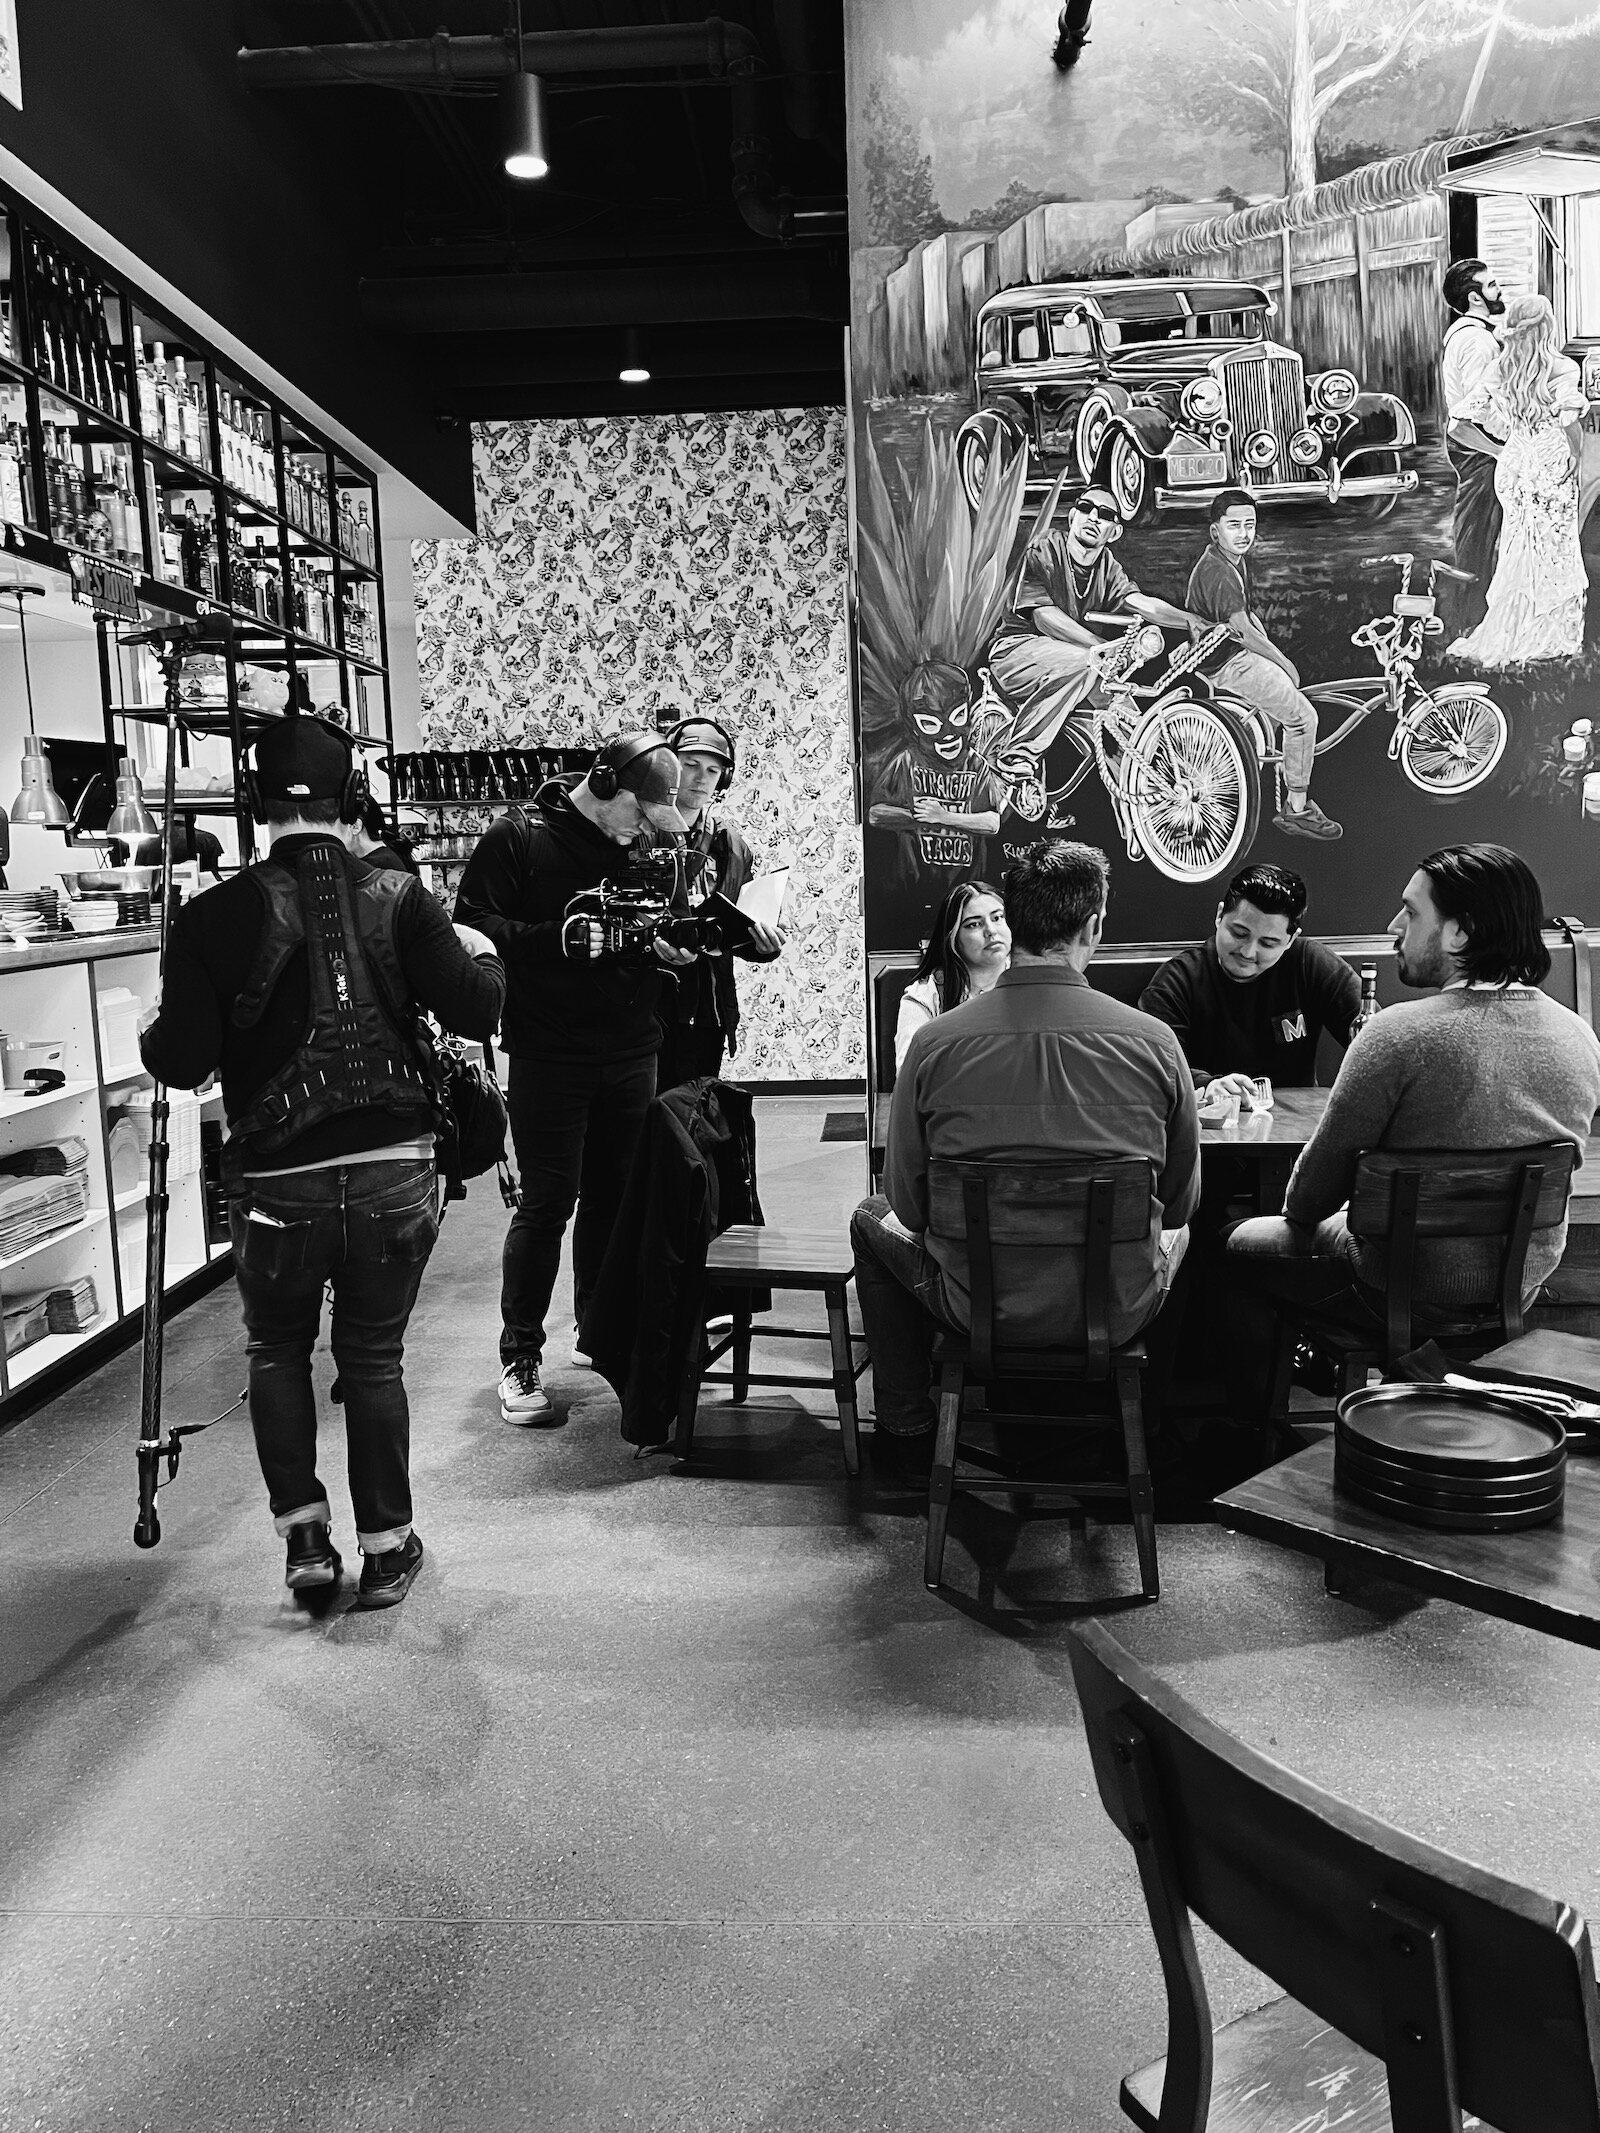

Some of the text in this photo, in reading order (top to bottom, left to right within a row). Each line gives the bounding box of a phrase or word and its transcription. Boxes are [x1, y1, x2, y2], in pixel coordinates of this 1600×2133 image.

[913, 766, 975, 799] STRAIGHT
[923, 836, 970, 862] TACOS
[1281, 1013, 1307, 1042] M
